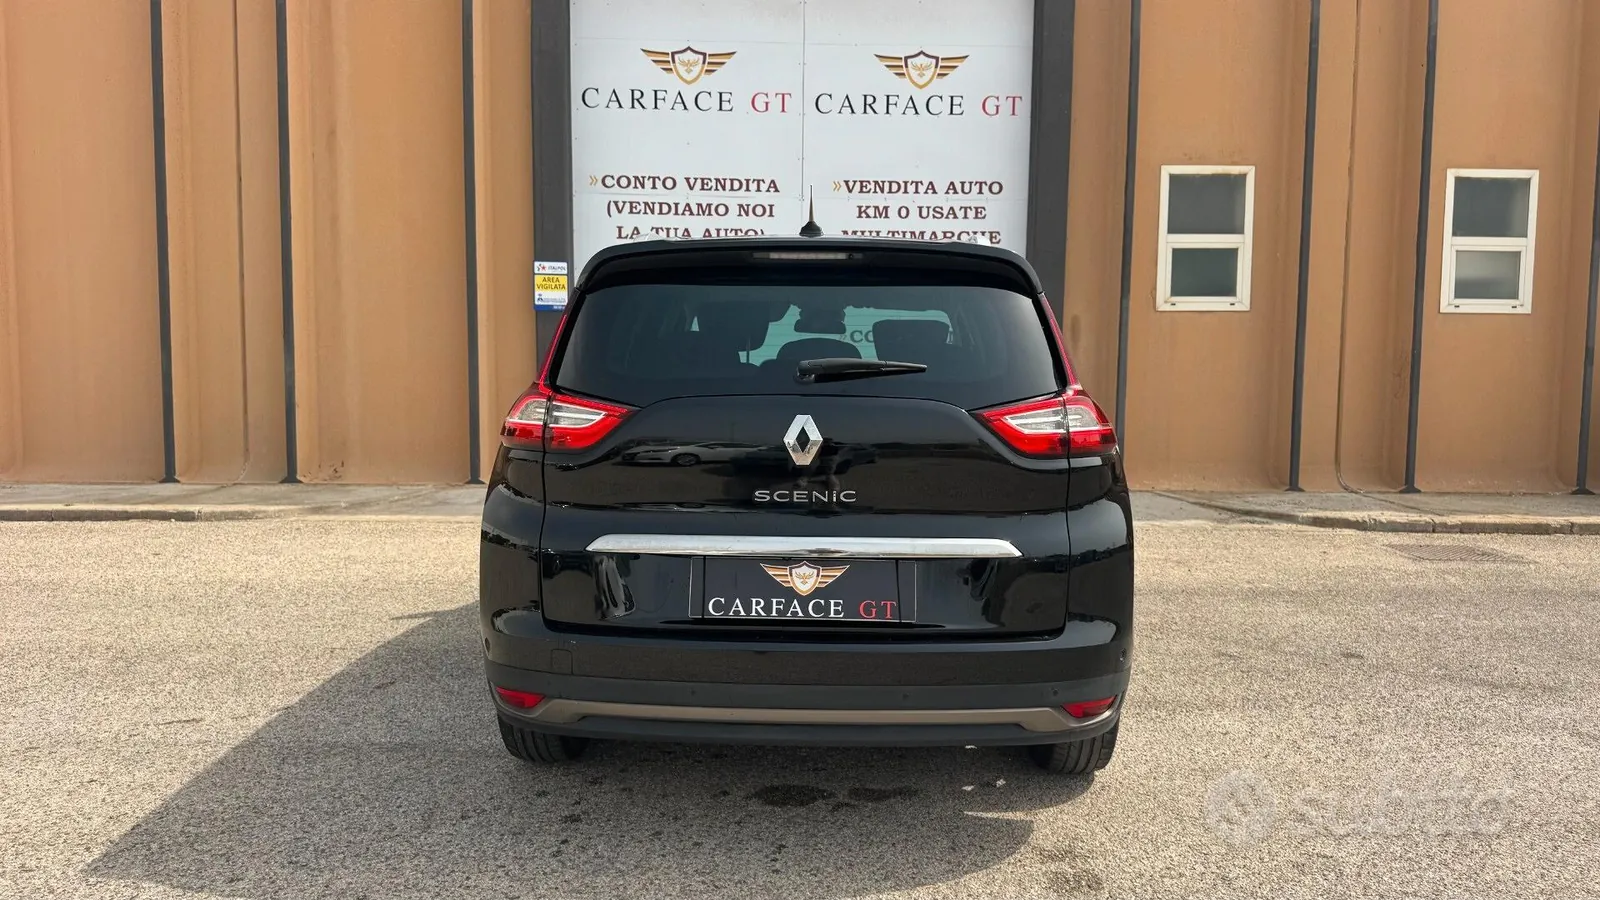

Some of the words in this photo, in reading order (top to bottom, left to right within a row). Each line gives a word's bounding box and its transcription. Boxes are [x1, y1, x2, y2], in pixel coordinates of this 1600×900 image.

[581, 86, 734, 112] CARFACE
[750, 91, 793, 113] GT
[814, 92, 965, 117] CARFACE
[981, 95, 1023, 117] GT
[601, 174, 677, 191] CONTO
[684, 177, 780, 193] VENDITA
[843, 180, 938, 194] VENDITA
[944, 181, 1004, 195] AUTO
[607, 200, 729, 217] (VENDIAMO
[737, 203, 775, 218] NOI
[856, 205, 890, 219] KM
[917, 206, 987, 220] USATE
[616, 226, 641, 240] LA
[841, 230, 1001, 244] TIMARCE
[708, 597, 844, 618] CARFACE
[859, 600, 897, 619] GT
